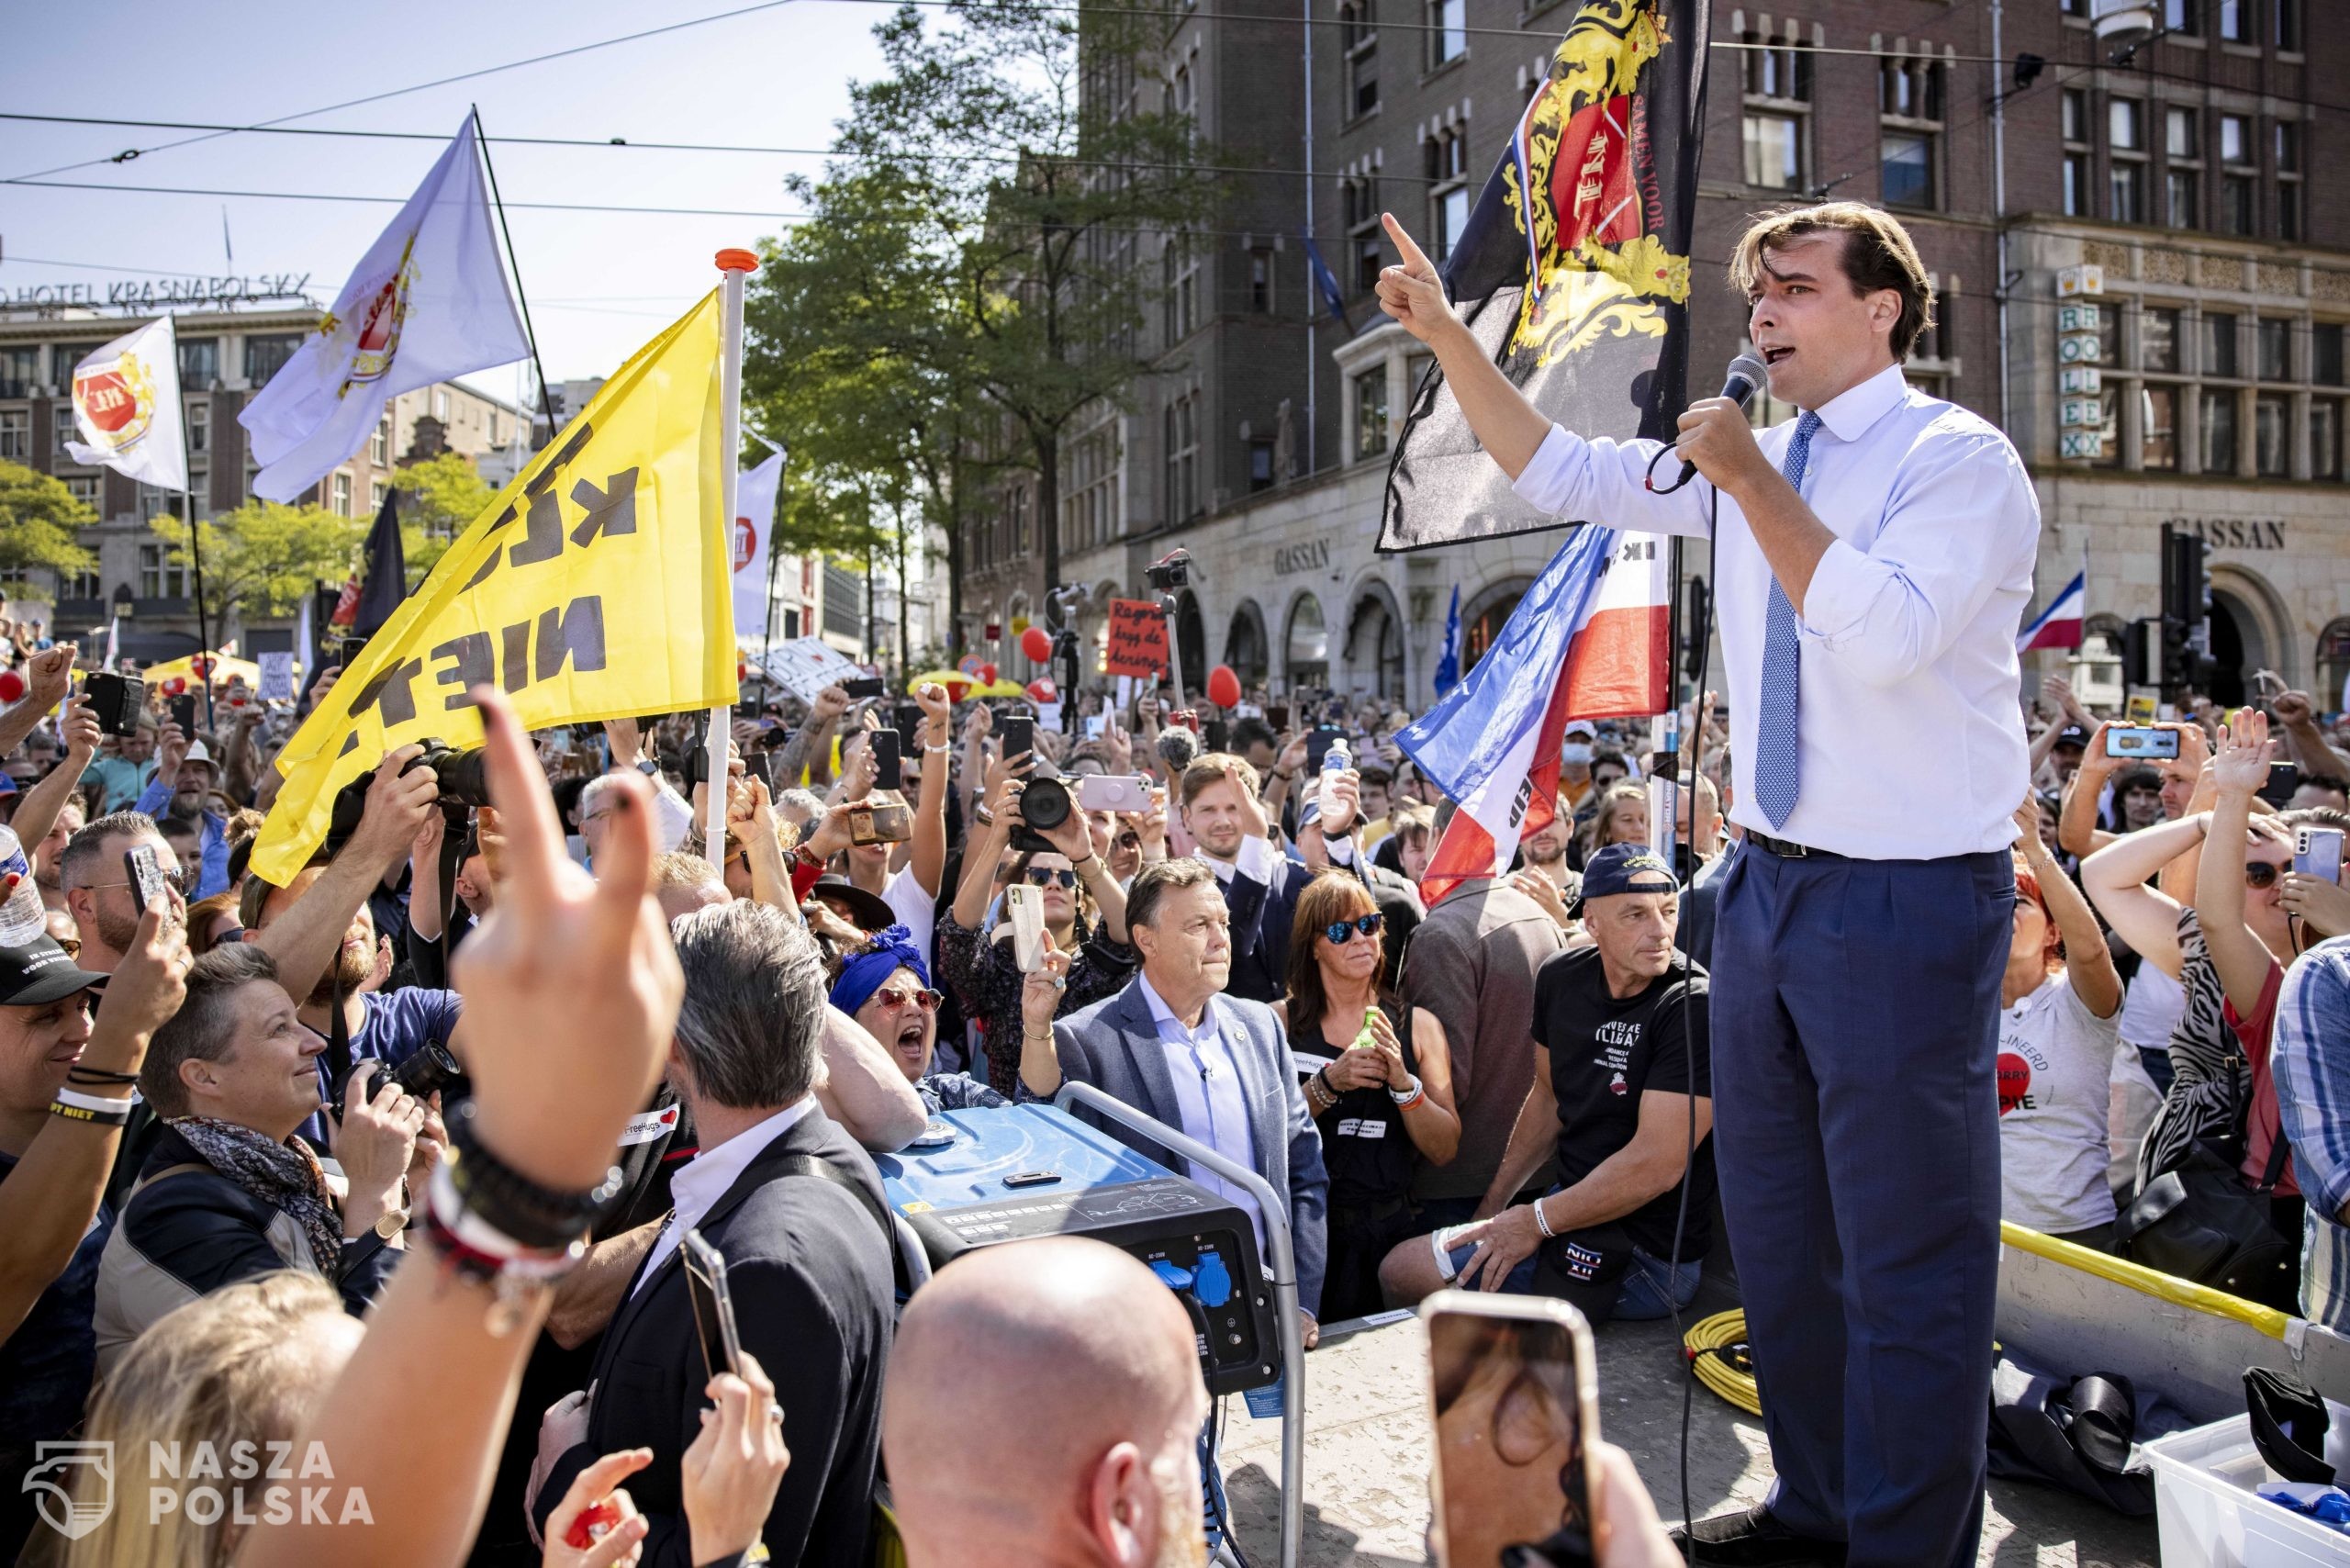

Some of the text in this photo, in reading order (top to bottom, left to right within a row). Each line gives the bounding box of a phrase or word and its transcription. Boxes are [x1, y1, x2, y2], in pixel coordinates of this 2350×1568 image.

[1632, 95, 1665, 230] SAMEN VOOR
[17, 283, 100, 305] HOTEL
[108, 272, 310, 303] KRASNAPOLSKY
[2063, 309, 2082, 454] ROLEX
[1274, 538, 1330, 576] GASSAN
[22, 959, 49, 975] VOOR
[2000, 1034, 2049, 1071] INEERD
[62, 1105, 95, 1120] NIET
[625, 1122, 661, 1135] FreeHugs
